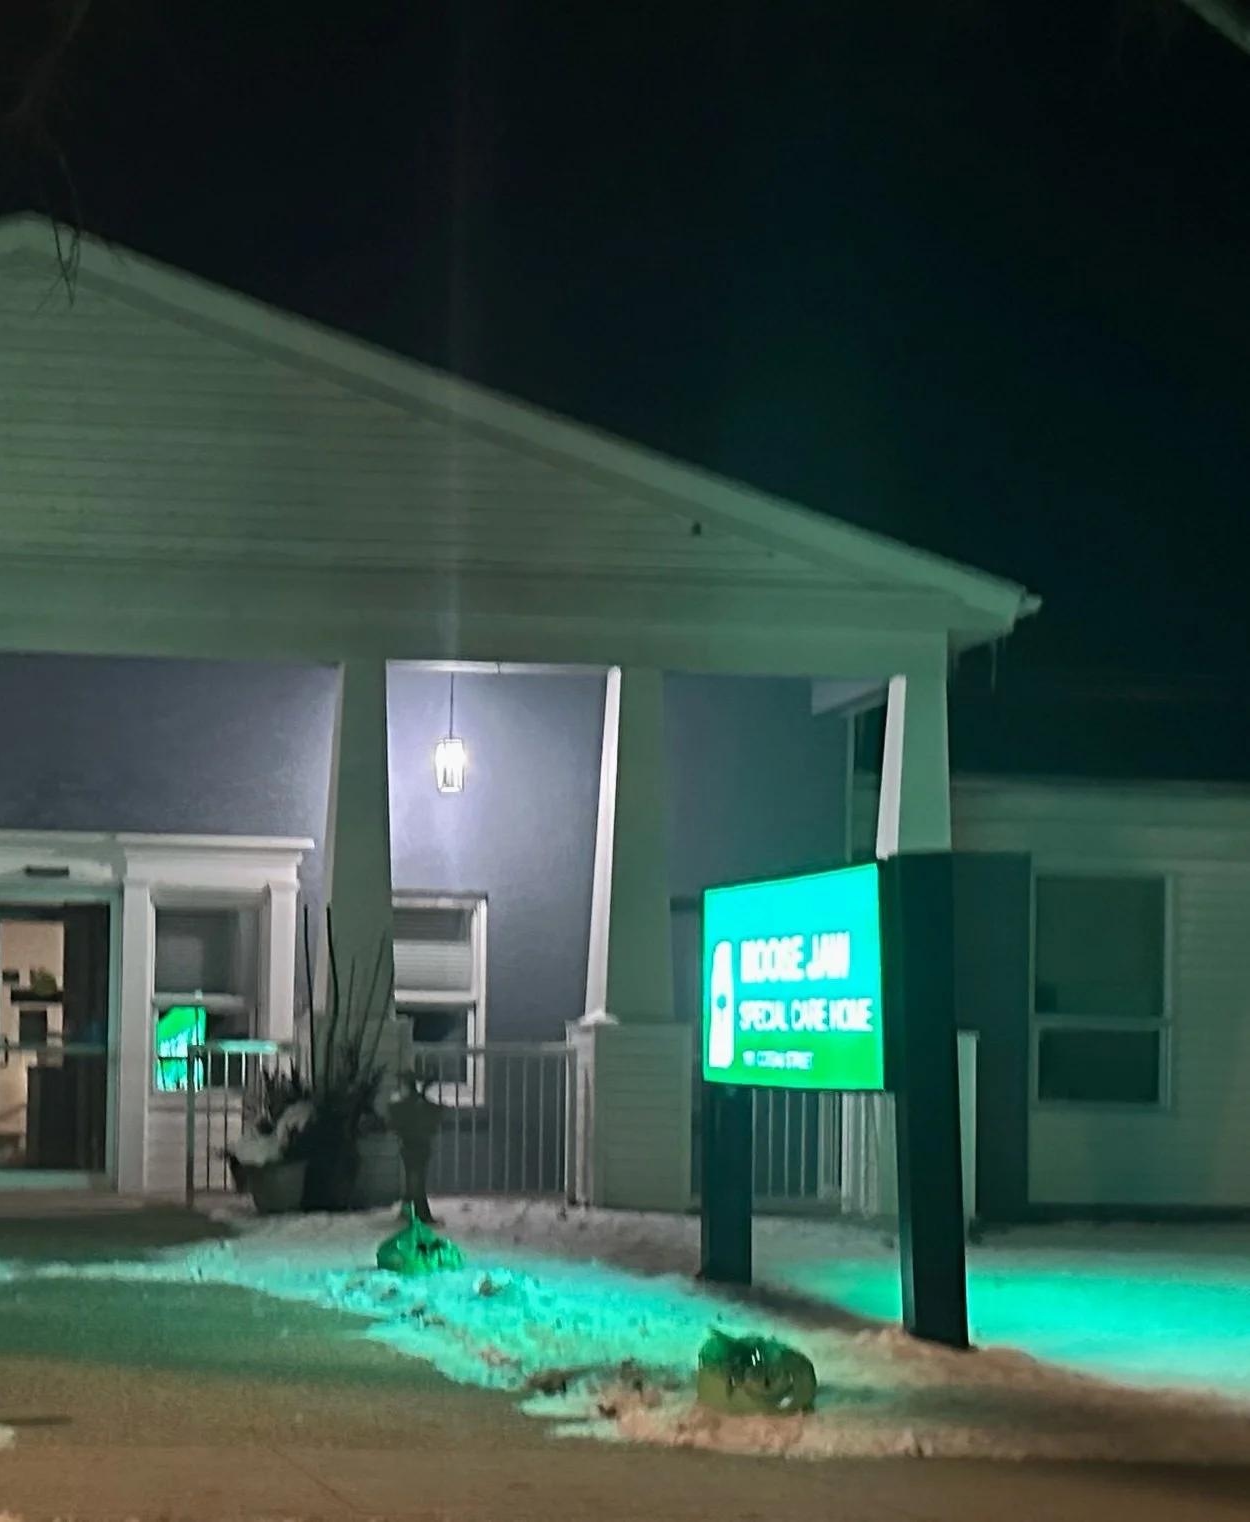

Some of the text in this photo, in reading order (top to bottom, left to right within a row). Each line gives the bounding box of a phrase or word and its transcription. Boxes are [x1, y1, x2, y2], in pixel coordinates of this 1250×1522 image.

[740, 931, 850, 983] MOOSE JAW
[739, 998, 873, 1031] SPECIAL CARE HOME
